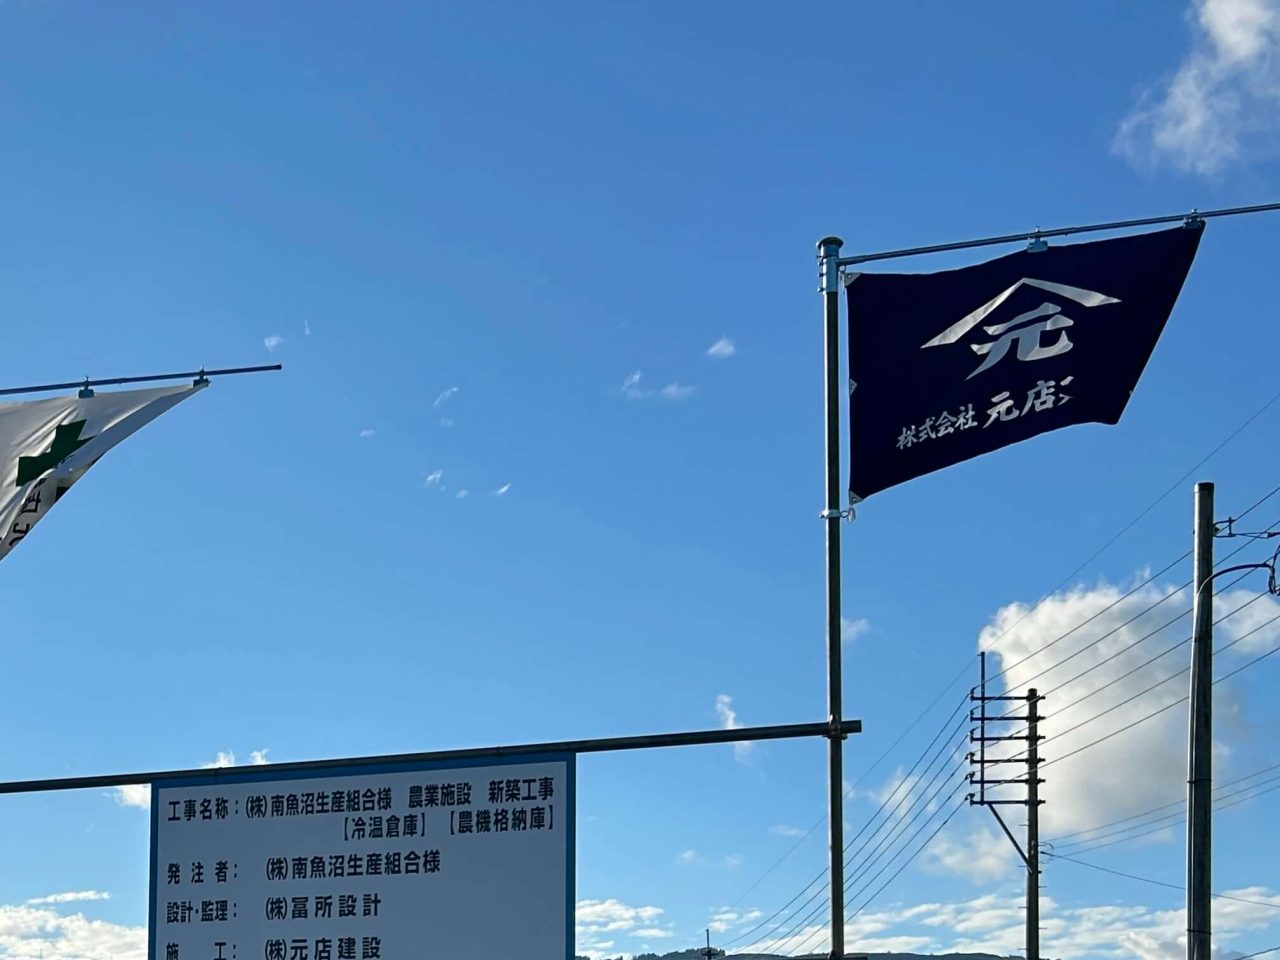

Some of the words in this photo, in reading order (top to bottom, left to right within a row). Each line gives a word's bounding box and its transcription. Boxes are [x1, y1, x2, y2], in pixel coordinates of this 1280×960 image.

[896, 376, 1074, 450] 株式会社元店
[408, 783, 472, 809] 農業施設
[488, 777, 554, 804] 新築工事
